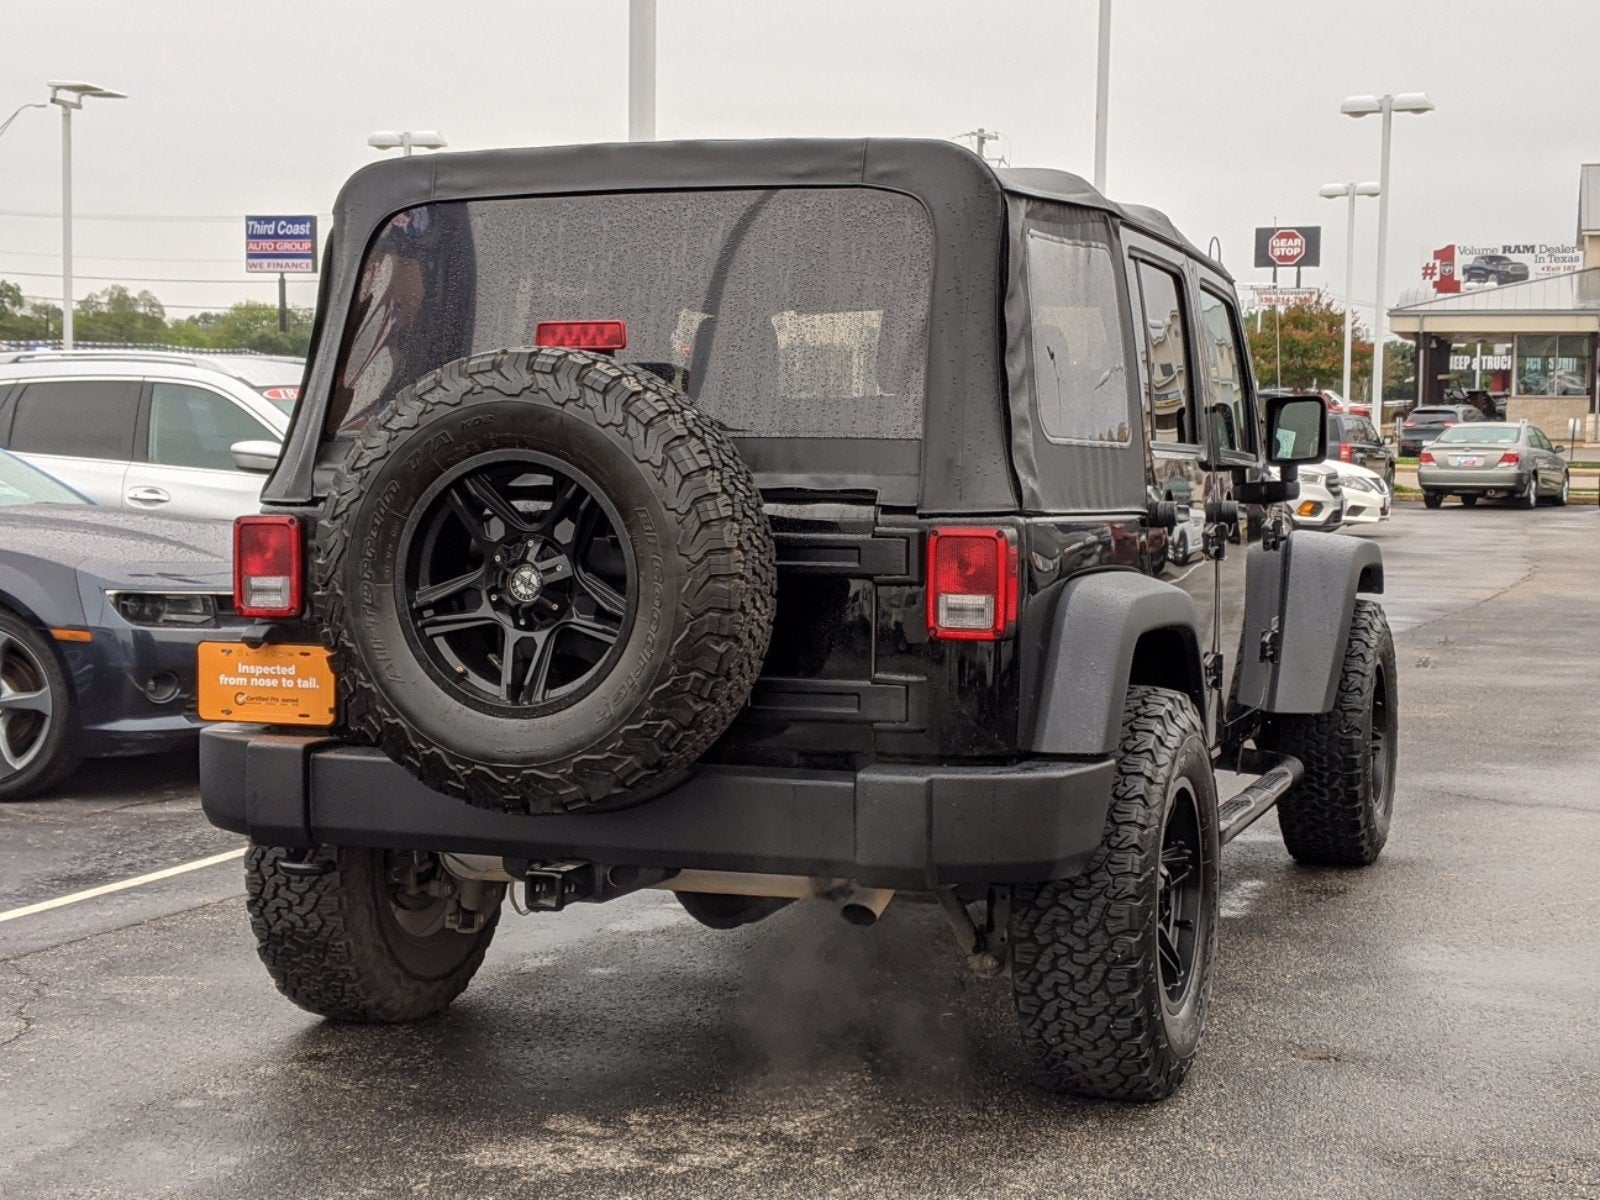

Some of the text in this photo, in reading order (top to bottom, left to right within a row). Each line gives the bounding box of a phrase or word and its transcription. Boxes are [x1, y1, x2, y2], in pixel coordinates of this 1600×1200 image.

[247, 220, 311, 235] Third Coast
[247, 242, 311, 251] AUTO GROUP
[1272, 237, 1302, 256] GEAR STOP
[1457, 244, 1577, 255] Volume RAM Dealer
[267, 262, 311, 270] FINANCE
[1534, 254, 1580, 263] In Texas
[402, 430, 455, 474] T/A
[237, 662, 297, 677] Inspected
[219, 673, 320, 689] from nose to tail.
